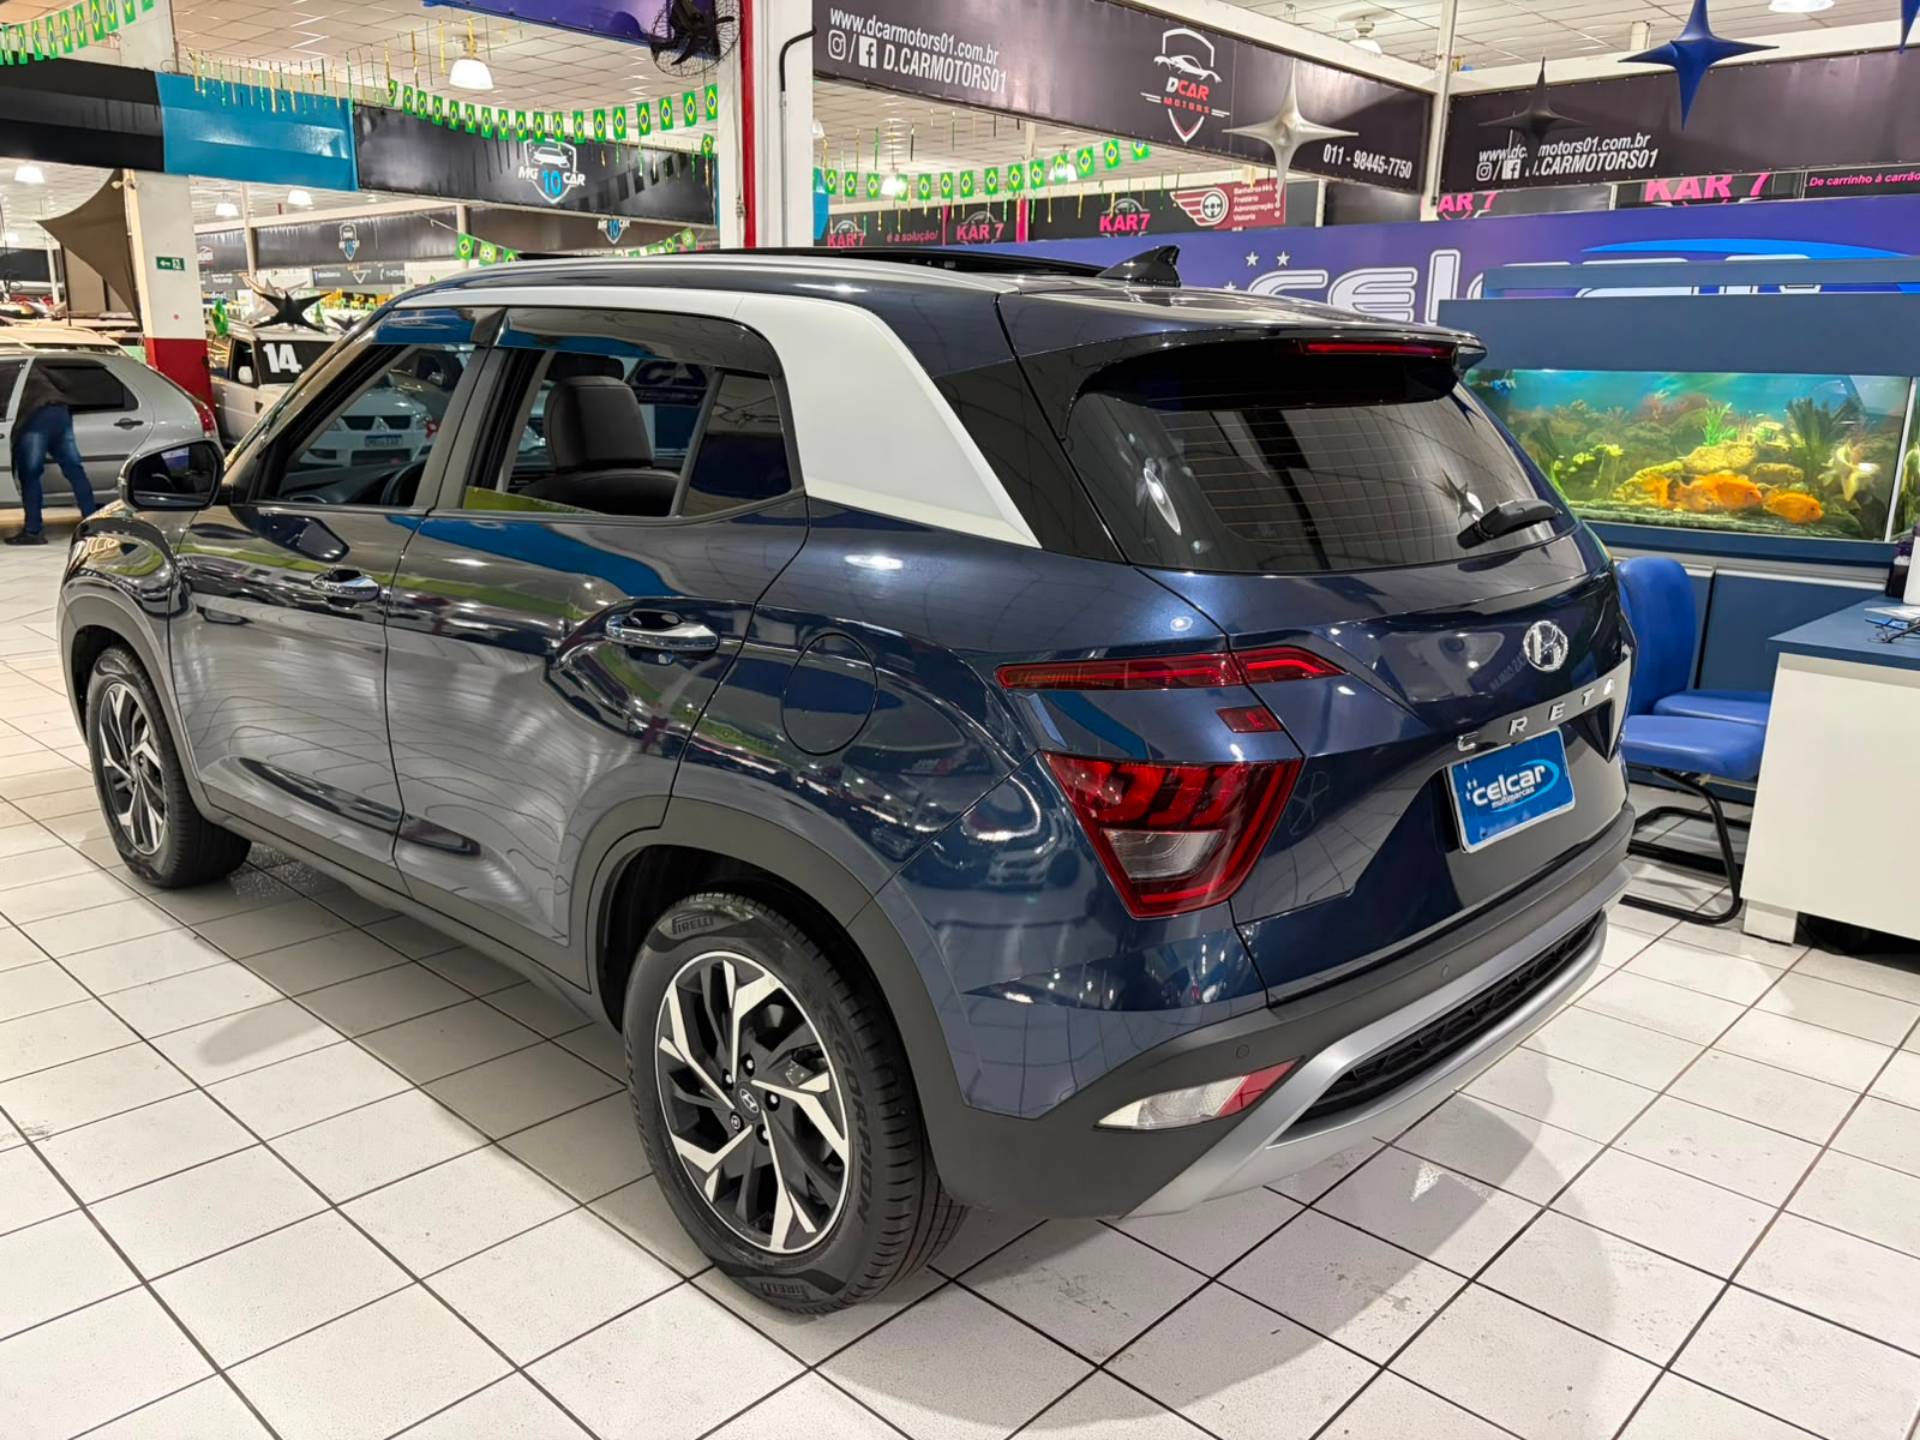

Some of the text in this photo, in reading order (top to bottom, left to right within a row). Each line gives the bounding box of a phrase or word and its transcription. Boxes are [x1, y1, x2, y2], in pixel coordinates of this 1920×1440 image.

[829, 7, 1000, 66] www.dcarmotors01.com.br
[882, 43, 1008, 95] D.CARMOTORS01
[1162, 96, 1211, 114] MOTORS
[1165, 76, 1210, 102] DCAR
[1322, 143, 1345, 166] 011
[1353, 149, 1413, 180] 98445-7750
[517, 165, 586, 198] MG 10 CAR
[1644, 175, 1733, 203] KAR
[1809, 176, 1825, 188] De
[1826, 174, 1874, 187] carrinho
[1438, 191, 1475, 214] AR
[262, 342, 303, 374] 14
[1457, 678, 1616, 752] CRETA
[1471, 764, 1546, 808] celcar
[671, 910, 715, 936] PIRELLI
